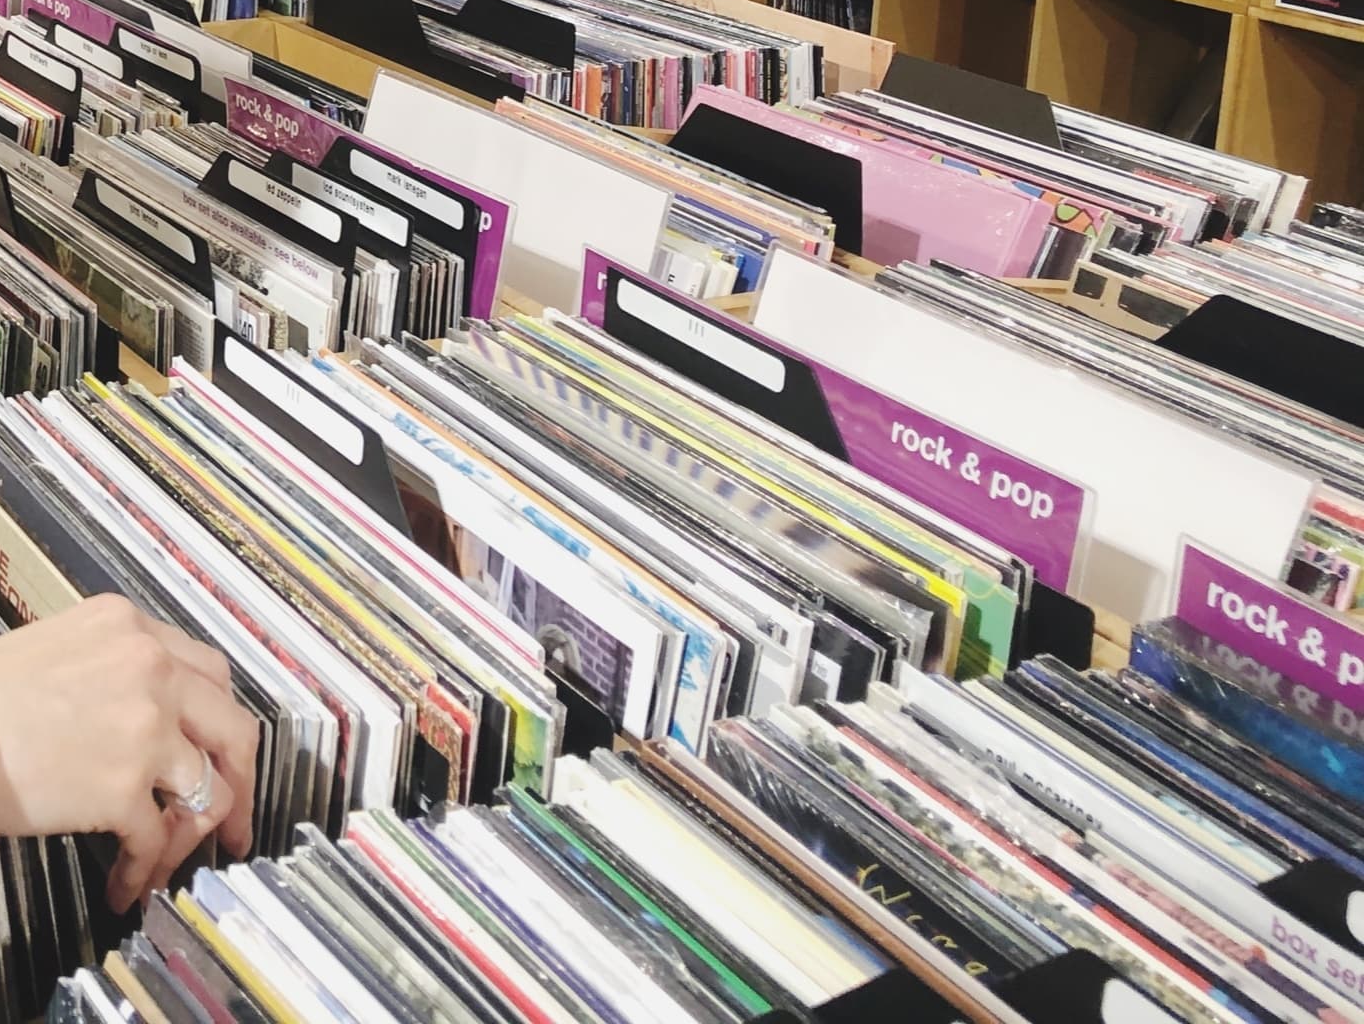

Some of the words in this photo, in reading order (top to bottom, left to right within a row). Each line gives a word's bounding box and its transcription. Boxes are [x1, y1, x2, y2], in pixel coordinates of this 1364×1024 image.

[54, 0, 71, 20] pop
[236, 93, 262, 118] rock
[263, 103, 273, 123] &
[275, 112, 299, 139] pop
[266, 181, 276, 195] led
[182, 190, 197, 209] box
[198, 201, 211, 218] set
[211, 209, 229, 228] also
[229, 220, 267, 251] available
[274, 246, 291, 264] see
[291, 251, 319, 280] below
[890, 421, 953, 470] rock
[959, 451, 981, 485] &
[988, 469, 1054, 520] pop
[1206, 581, 1290, 647] rock
[1298, 626, 1327, 668] &
[1271, 915, 1318, 966] box
